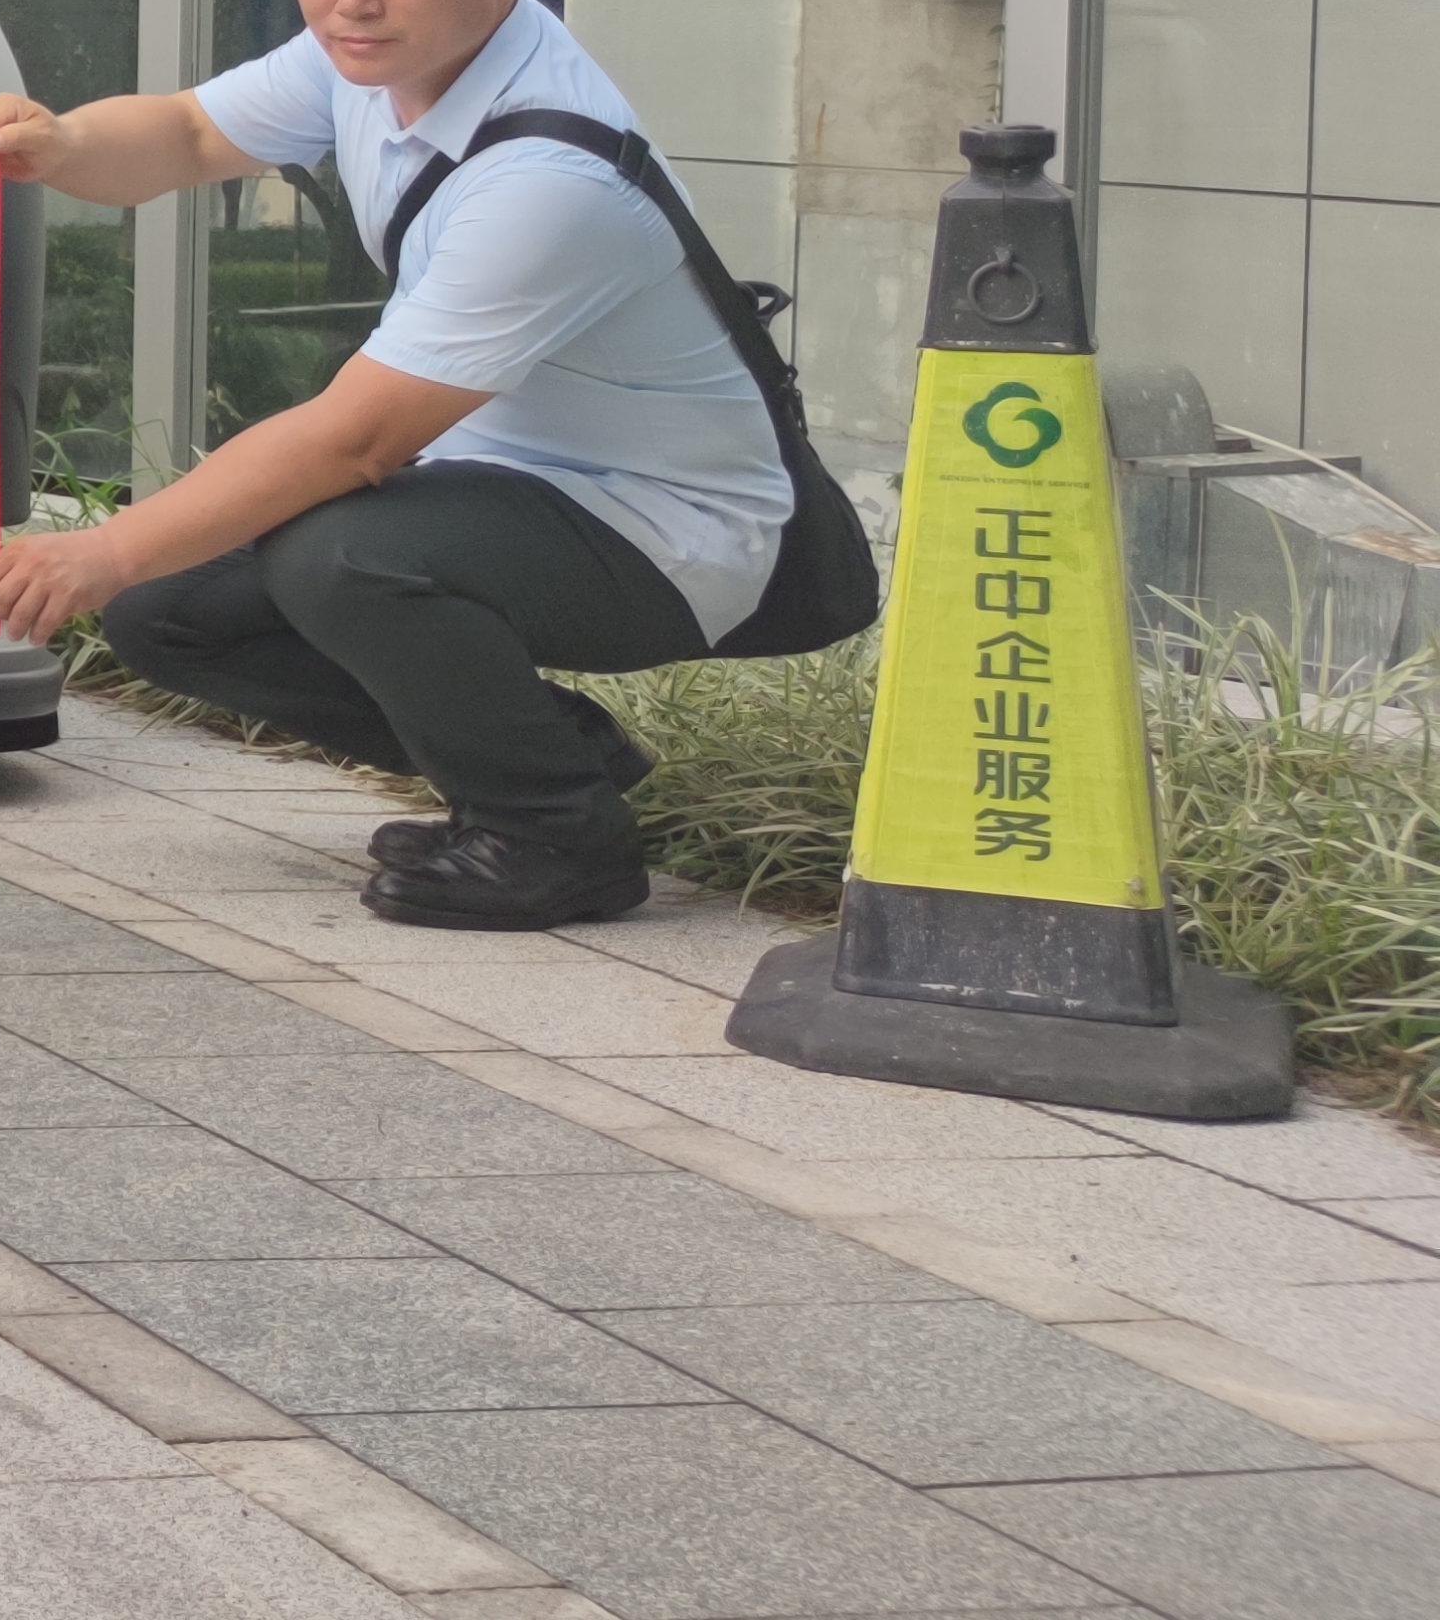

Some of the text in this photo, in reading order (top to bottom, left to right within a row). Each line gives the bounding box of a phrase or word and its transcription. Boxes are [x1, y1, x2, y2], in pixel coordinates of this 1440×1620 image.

[973, 507, 1053, 861] 正中企业服务
